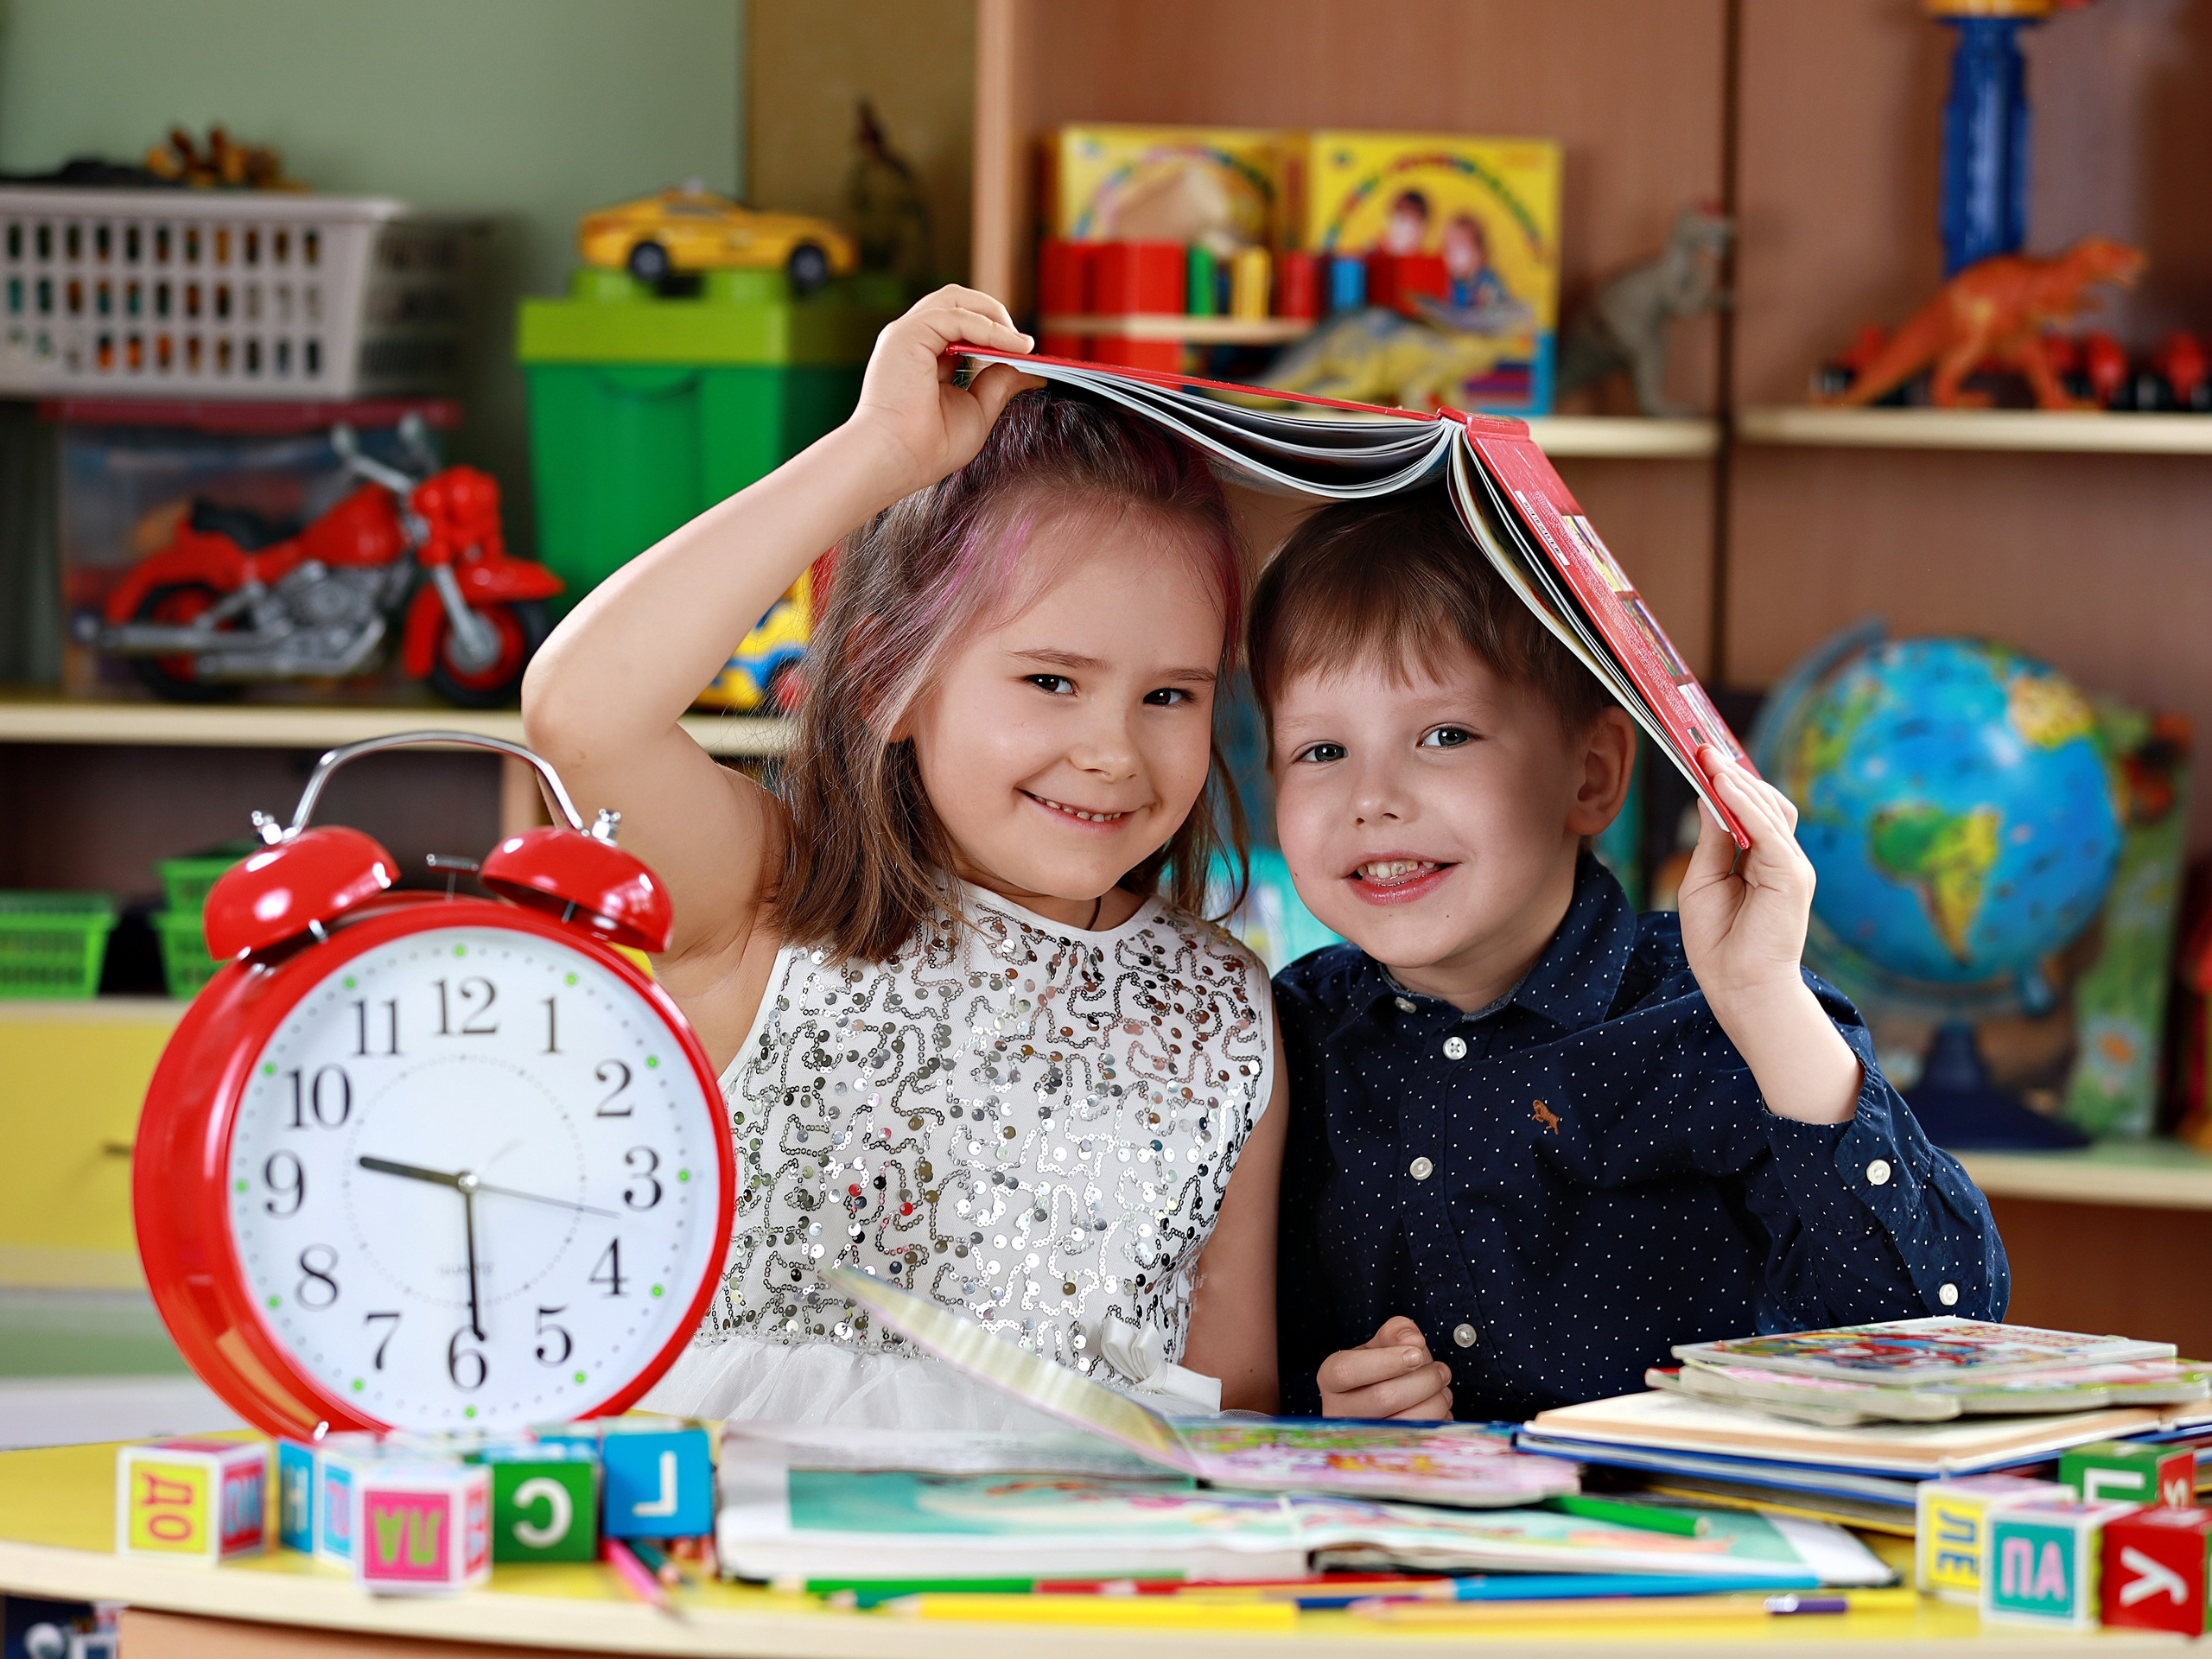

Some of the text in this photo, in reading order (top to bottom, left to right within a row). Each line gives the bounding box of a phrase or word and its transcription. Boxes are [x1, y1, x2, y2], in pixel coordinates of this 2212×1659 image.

[350, 997, 403, 1057] 11
[434, 977, 499, 1036] 12
[542, 996, 563, 1055] 1
[286, 1064, 353, 1130] 10
[594, 1059, 633, 1118] 2
[262, 1150, 306, 1219] 9
[623, 1146, 664, 1211] 3
[296, 1244, 340, 1312] 8
[588, 1236, 631, 1298] 4
[365, 1313, 404, 1371] 7
[448, 1325, 489, 1393] 6
[534, 1304, 574, 1368] 5
[2000, 1535, 2067, 1601] ПА
